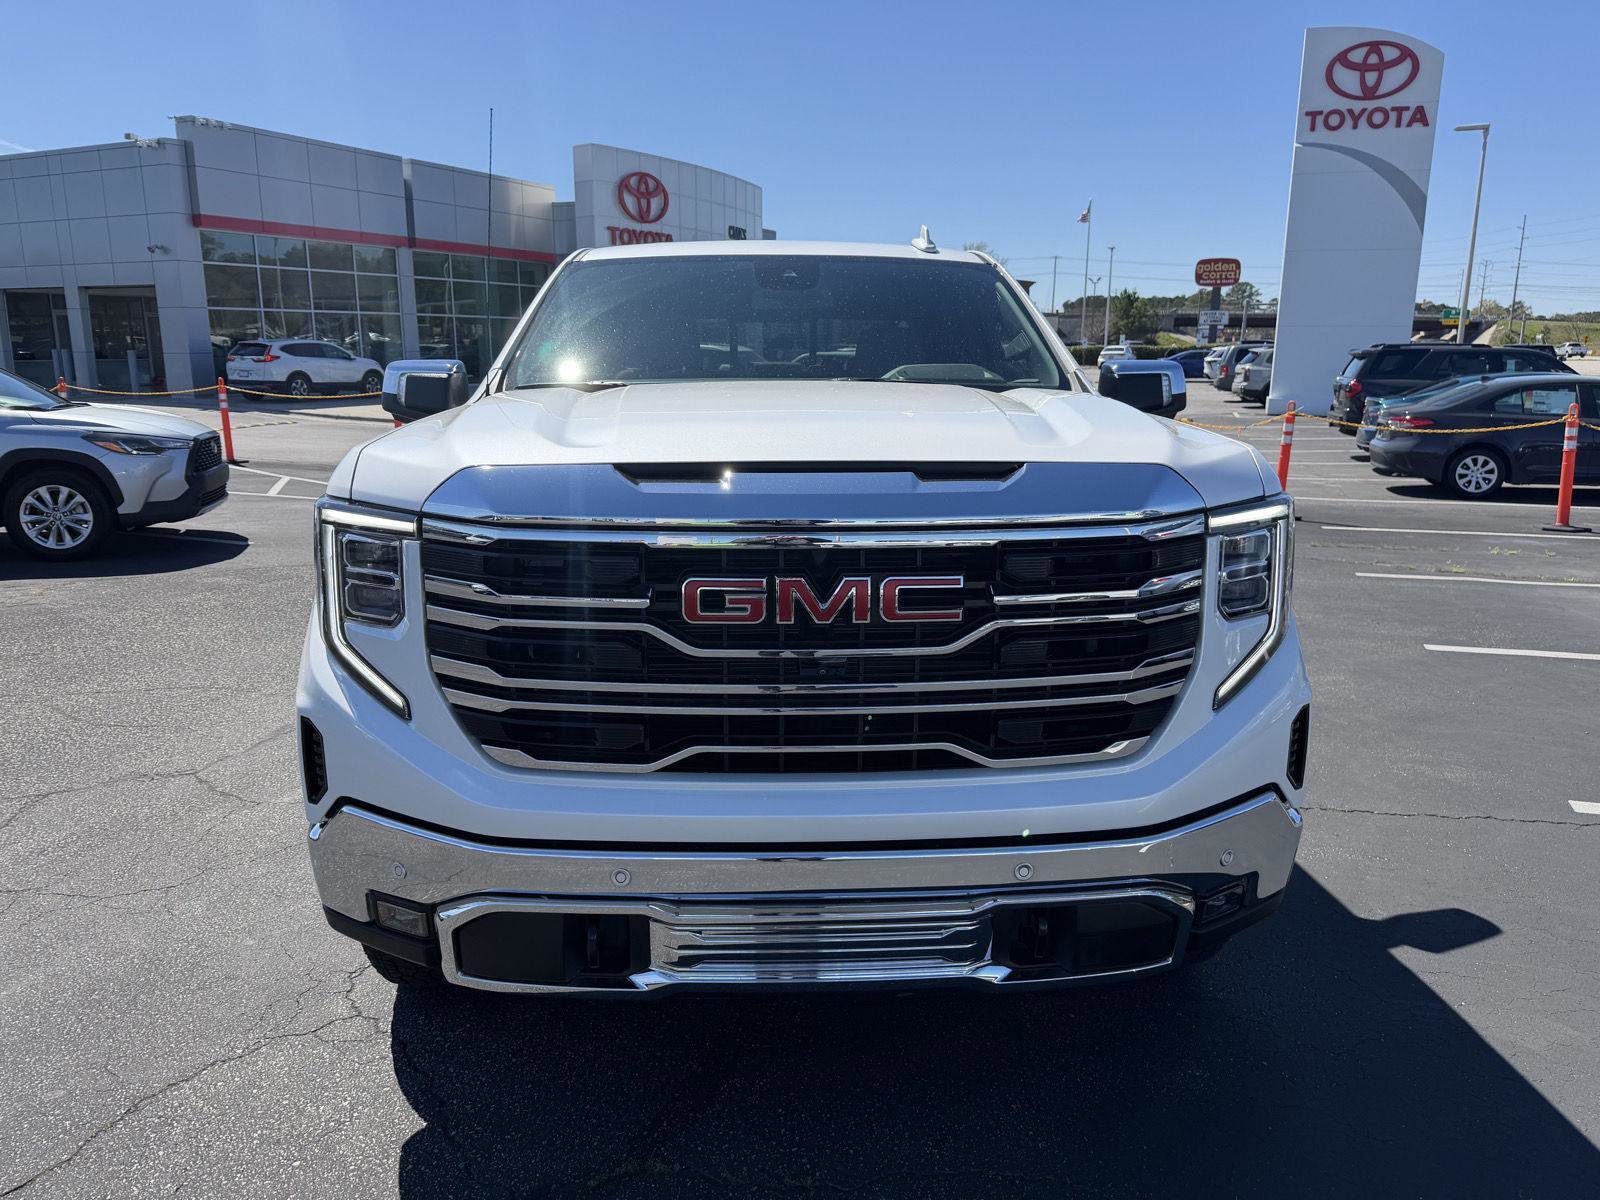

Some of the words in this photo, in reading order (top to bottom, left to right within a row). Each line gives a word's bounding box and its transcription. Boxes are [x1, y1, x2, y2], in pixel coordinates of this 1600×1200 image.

[1304, 105, 1430, 132] TOYOTA
[1197, 262, 1236, 273] golden
[1202, 270, 1239, 280] corral
[681, 575, 964, 625] GMC
